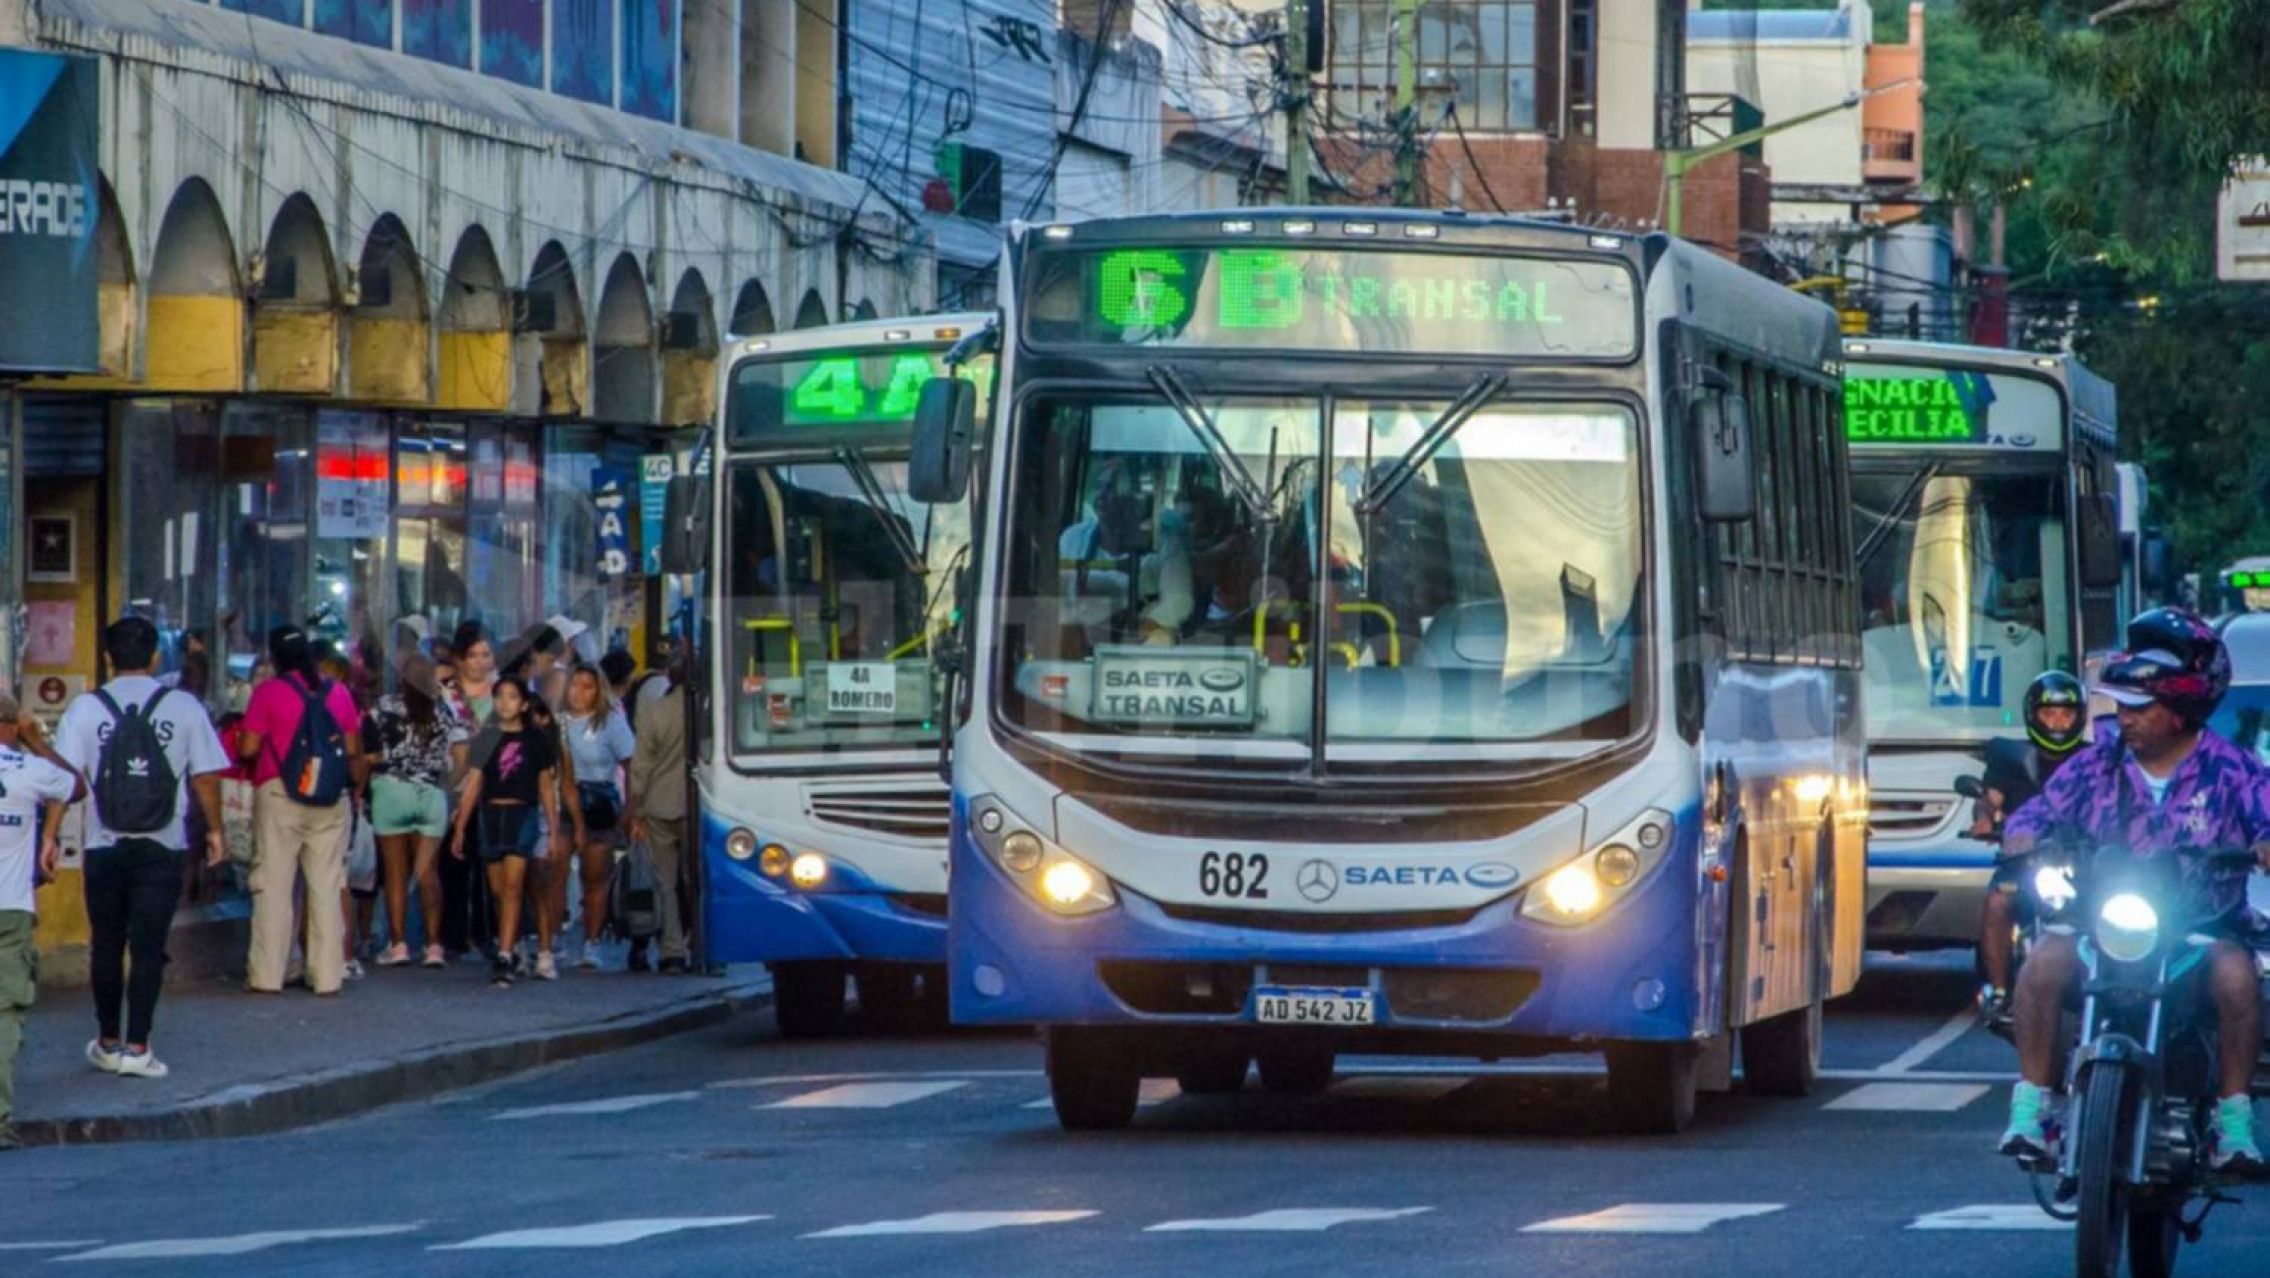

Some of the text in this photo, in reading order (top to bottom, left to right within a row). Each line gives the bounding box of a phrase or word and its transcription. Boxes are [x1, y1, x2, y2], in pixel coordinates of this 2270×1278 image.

[1318, 276, 1563, 323] TRANSAL
[1105, 670, 1194, 688] SAETA
[831, 691, 894, 708] ROMERO
[1105, 694, 1242, 717] TRANSAL
[1200, 852, 1268, 898] 682
[1345, 866, 1459, 885] SAETA
[1263, 999, 1366, 1021] AD 542 JZ
